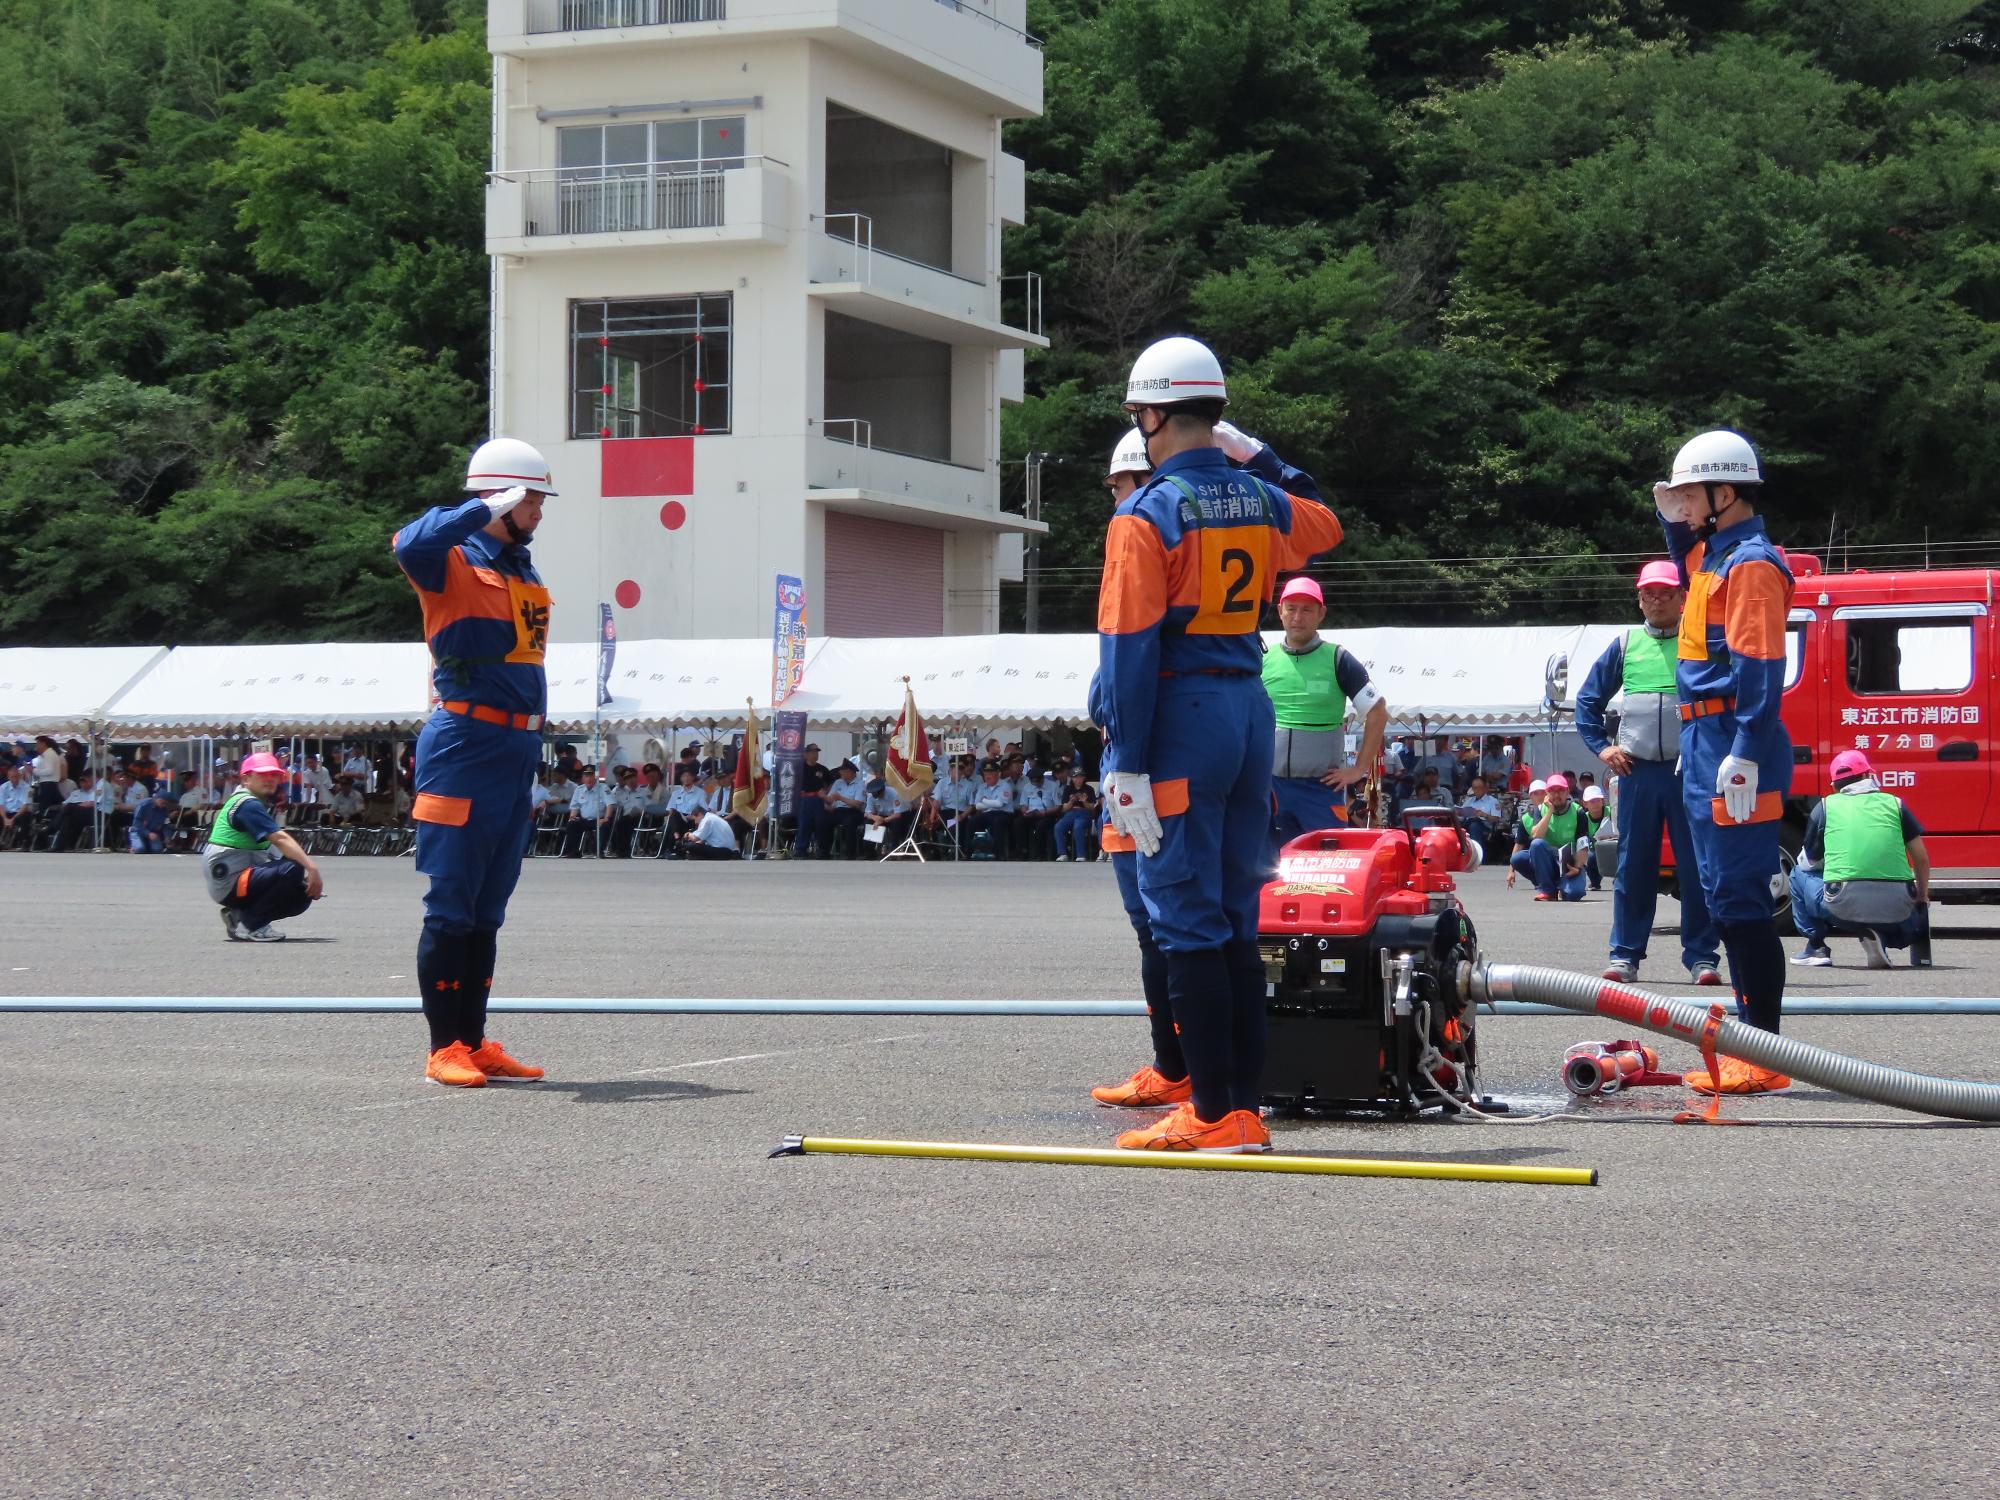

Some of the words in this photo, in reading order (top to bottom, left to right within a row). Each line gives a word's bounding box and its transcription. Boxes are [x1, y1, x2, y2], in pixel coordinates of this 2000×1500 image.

[1690, 462, 1749, 473] 高島市消防団
[1221, 548, 1255, 613] 2
[1840, 706, 1979, 725] 東近江市消防団
